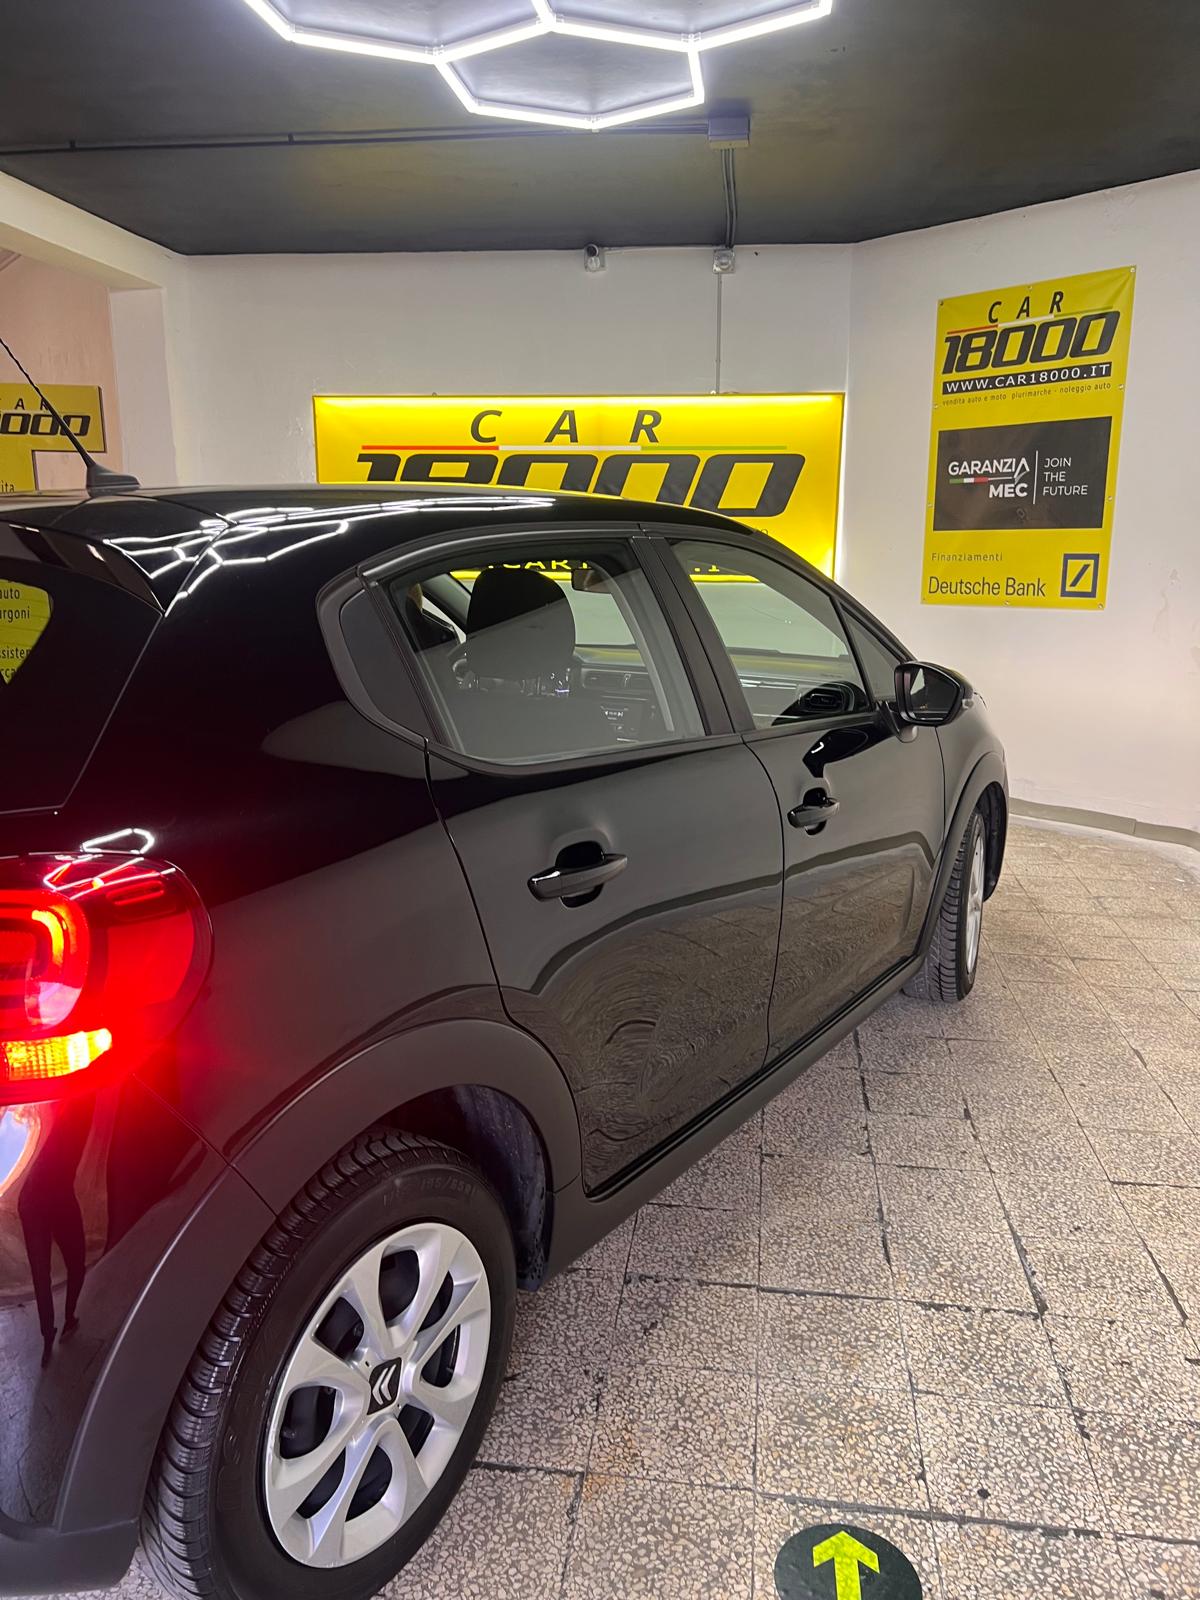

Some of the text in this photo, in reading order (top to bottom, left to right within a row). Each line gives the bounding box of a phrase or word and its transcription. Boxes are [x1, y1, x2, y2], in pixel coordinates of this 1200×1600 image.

[988, 291, 1064, 323] CAR
[942, 311, 1120, 374] 18000
[945, 364, 1110, 393] WWW.CAR18000.IT
[0, 397, 49, 410] AR
[942, 396, 966, 406] vendita
[967, 394, 982, 403] auto
[990, 392, 1007, 401] moto
[1011, 388, 1051, 401] plurimarche
[1059, 384, 1092, 396] noleggio
[1094, 382, 1112, 391] auto
[0, 413, 91, 436] 000
[470, 409, 662, 443] CAR
[948, 457, 1030, 478] GARANZIA
[1044, 457, 1072, 468] JOIN
[1043, 471, 1066, 482] THE
[988, 482, 1029, 499] MEC
[1042, 484, 1088, 496] FUTURE
[931, 552, 1003, 562] Finanziamenti
[928, 576, 1046, 597] Deutsche Bank
